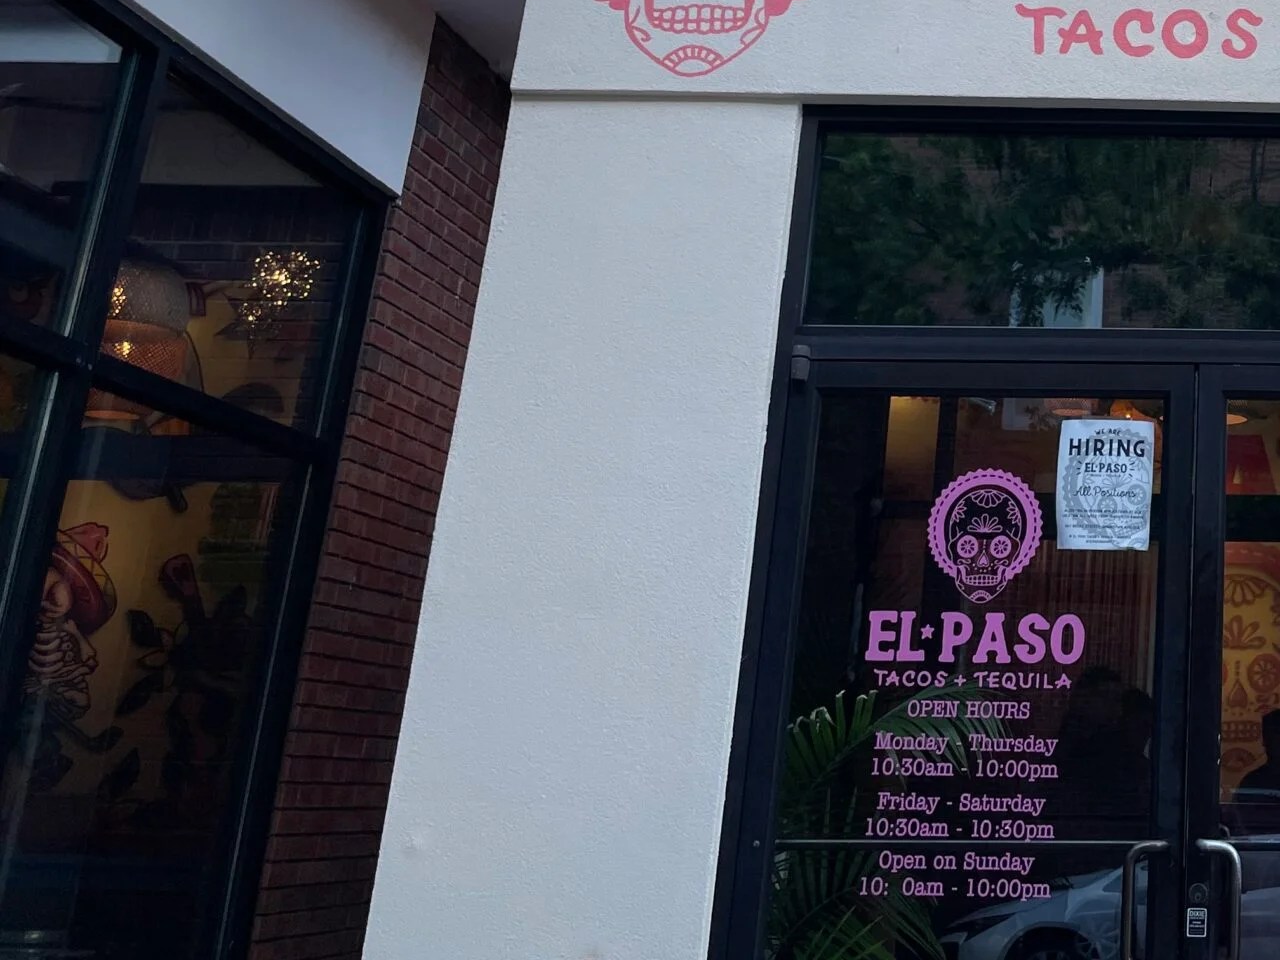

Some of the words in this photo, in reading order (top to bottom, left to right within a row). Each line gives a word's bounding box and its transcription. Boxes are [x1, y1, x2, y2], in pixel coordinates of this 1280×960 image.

[1015, 3, 1263, 60] TACOS
[1108, 428, 1122, 436] ARE
[1068, 438, 1146, 458] HIRING
[1084, 462, 1097, 473] EL
[1098, 462, 1128, 474] PASO
[1074, 485, 1092, 498] All
[1093, 486, 1137, 499] Positions
[864, 610, 925, 662] EL
[938, 611, 1086, 665] PASO
[873, 669, 949, 688] TACOS
[954, 675, 967, 687] +
[974, 670, 1073, 690] TEQUILA
[907, 700, 960, 718] OPEN
[966, 700, 1031, 720] HOURS
[874, 732, 948, 755] Monday
[968, 733, 1058, 756] Thursday
[871, 758, 954, 777] 10:30am
[975, 759, 1058, 782] 10:00pm
[876, 792, 941, 814] Friday
[959, 793, 1046, 816] Saturday
[865, 817, 949, 837] 10:30am
[971, 819, 1055, 841] 10:30pm
[879, 850, 927, 873] Open
[933, 855, 957, 870] on
[963, 851, 1035, 875] Sunday
[859, 876, 944, 897] 10:0am
[966, 878, 1051, 901] 10:00pm
